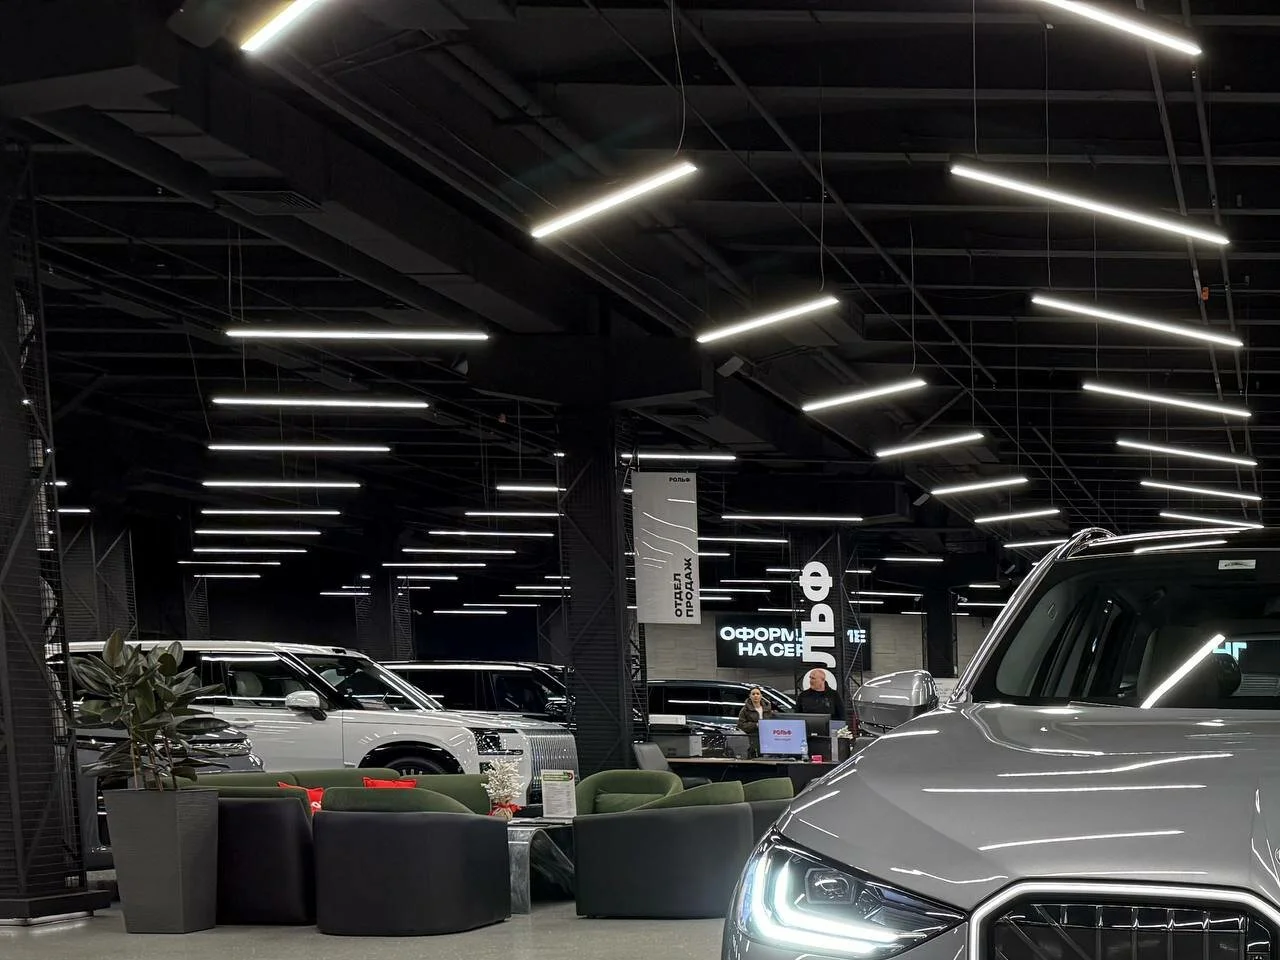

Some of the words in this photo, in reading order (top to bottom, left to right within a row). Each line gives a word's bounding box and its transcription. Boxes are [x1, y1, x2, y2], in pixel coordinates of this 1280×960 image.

[673, 573, 683, 618] ОТДЕЛ
[684, 558, 694, 618] ПРОДАЖ
[738, 642, 768, 657] НА
